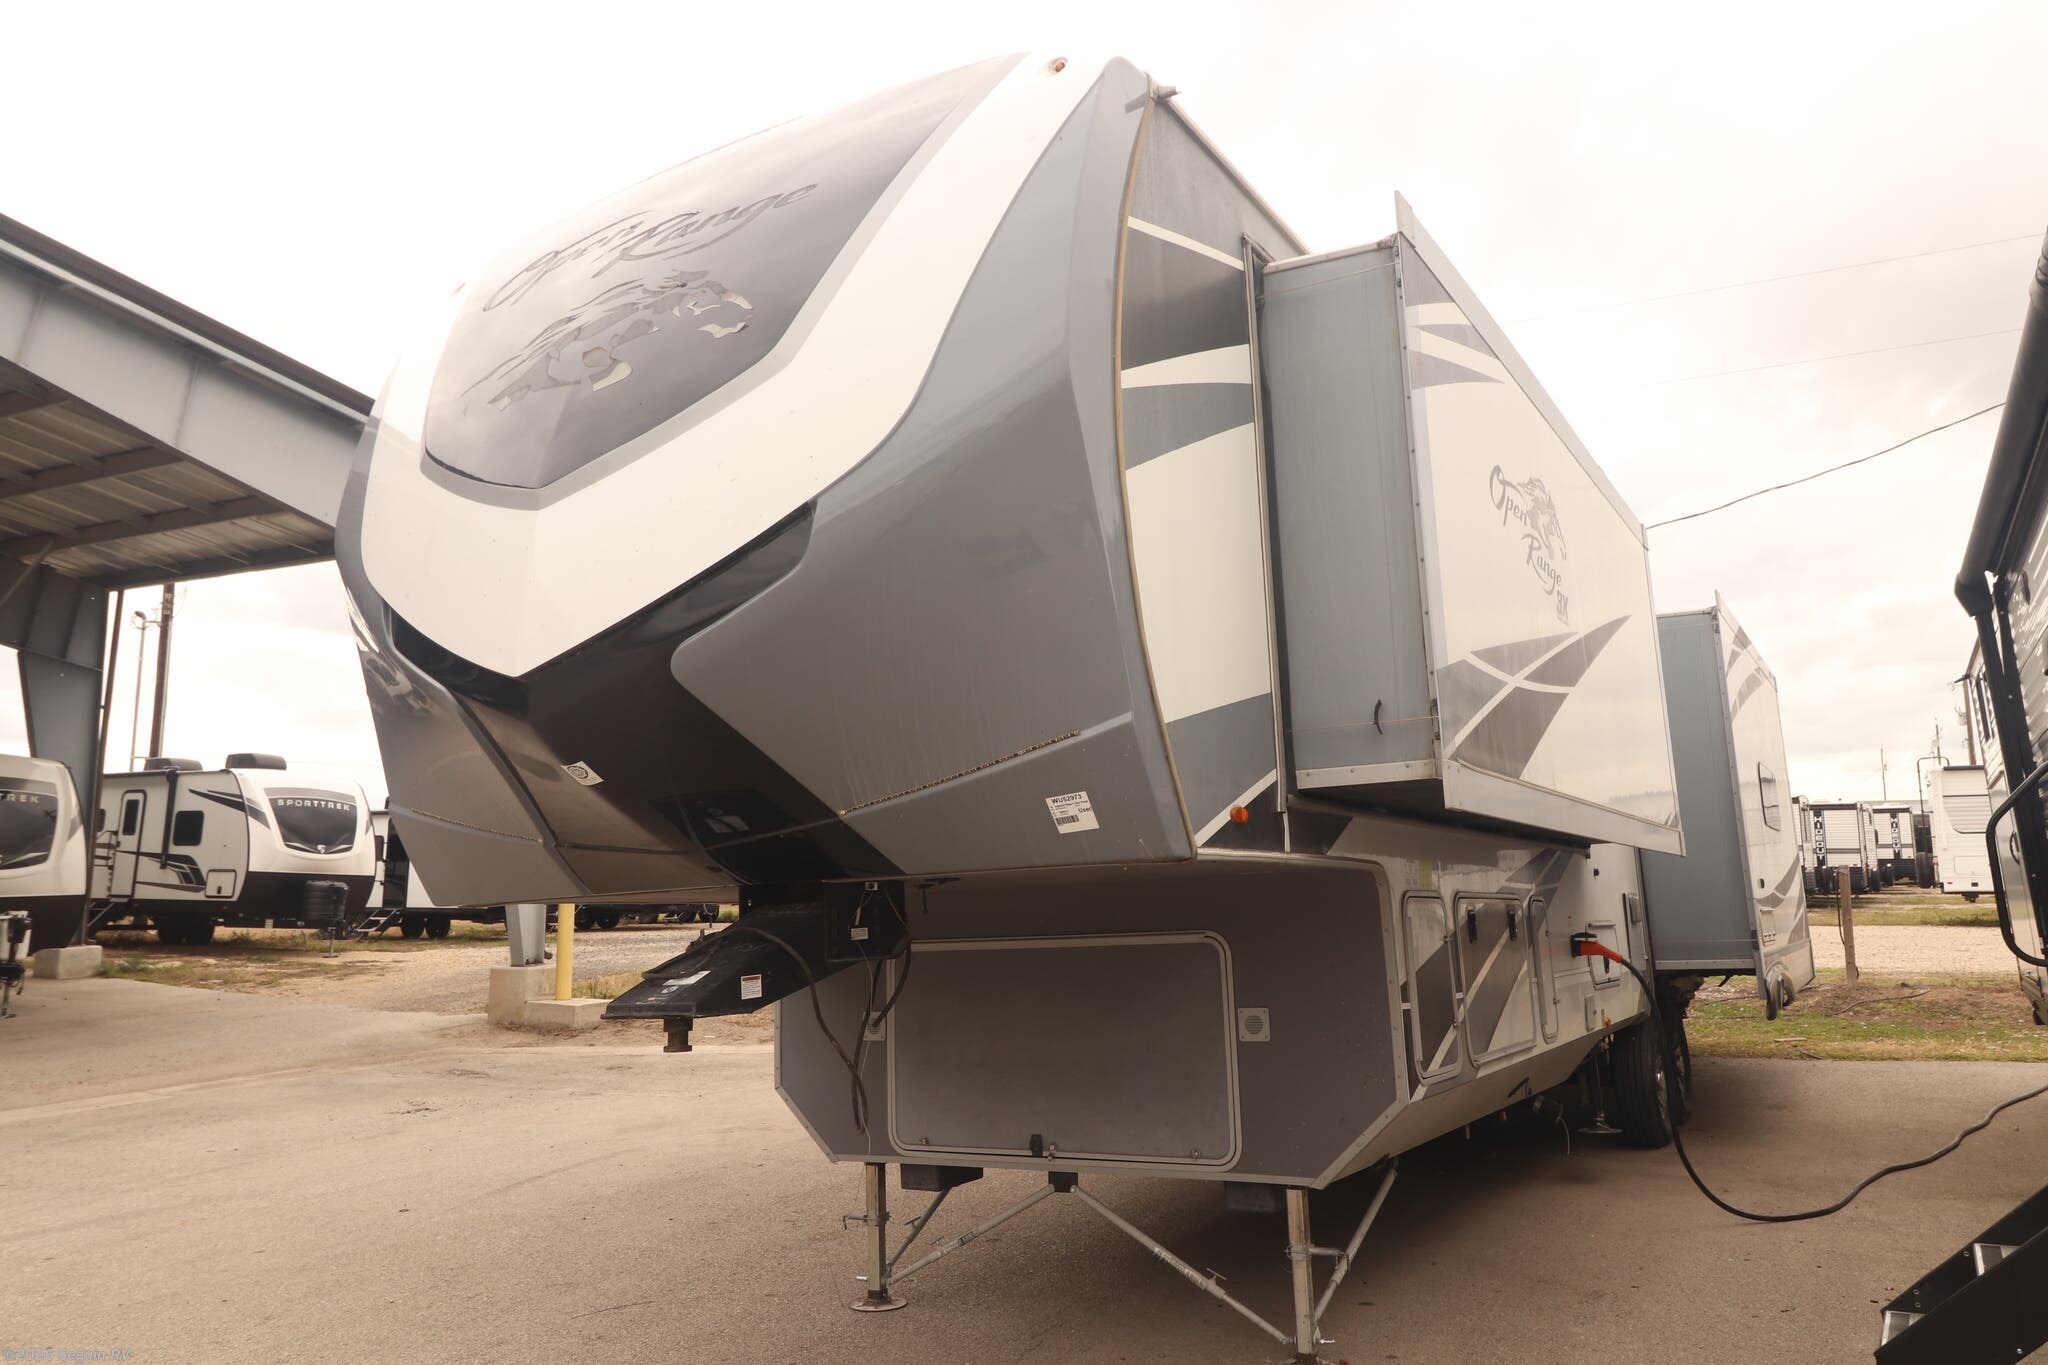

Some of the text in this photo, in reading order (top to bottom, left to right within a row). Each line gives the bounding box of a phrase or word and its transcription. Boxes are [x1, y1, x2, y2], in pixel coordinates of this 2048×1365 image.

[591, 183, 818, 279] Range
[1489, 464, 1528, 527] Open
[1521, 533, 1562, 596] Range
[277, 798, 350, 811] SPORTTREK
